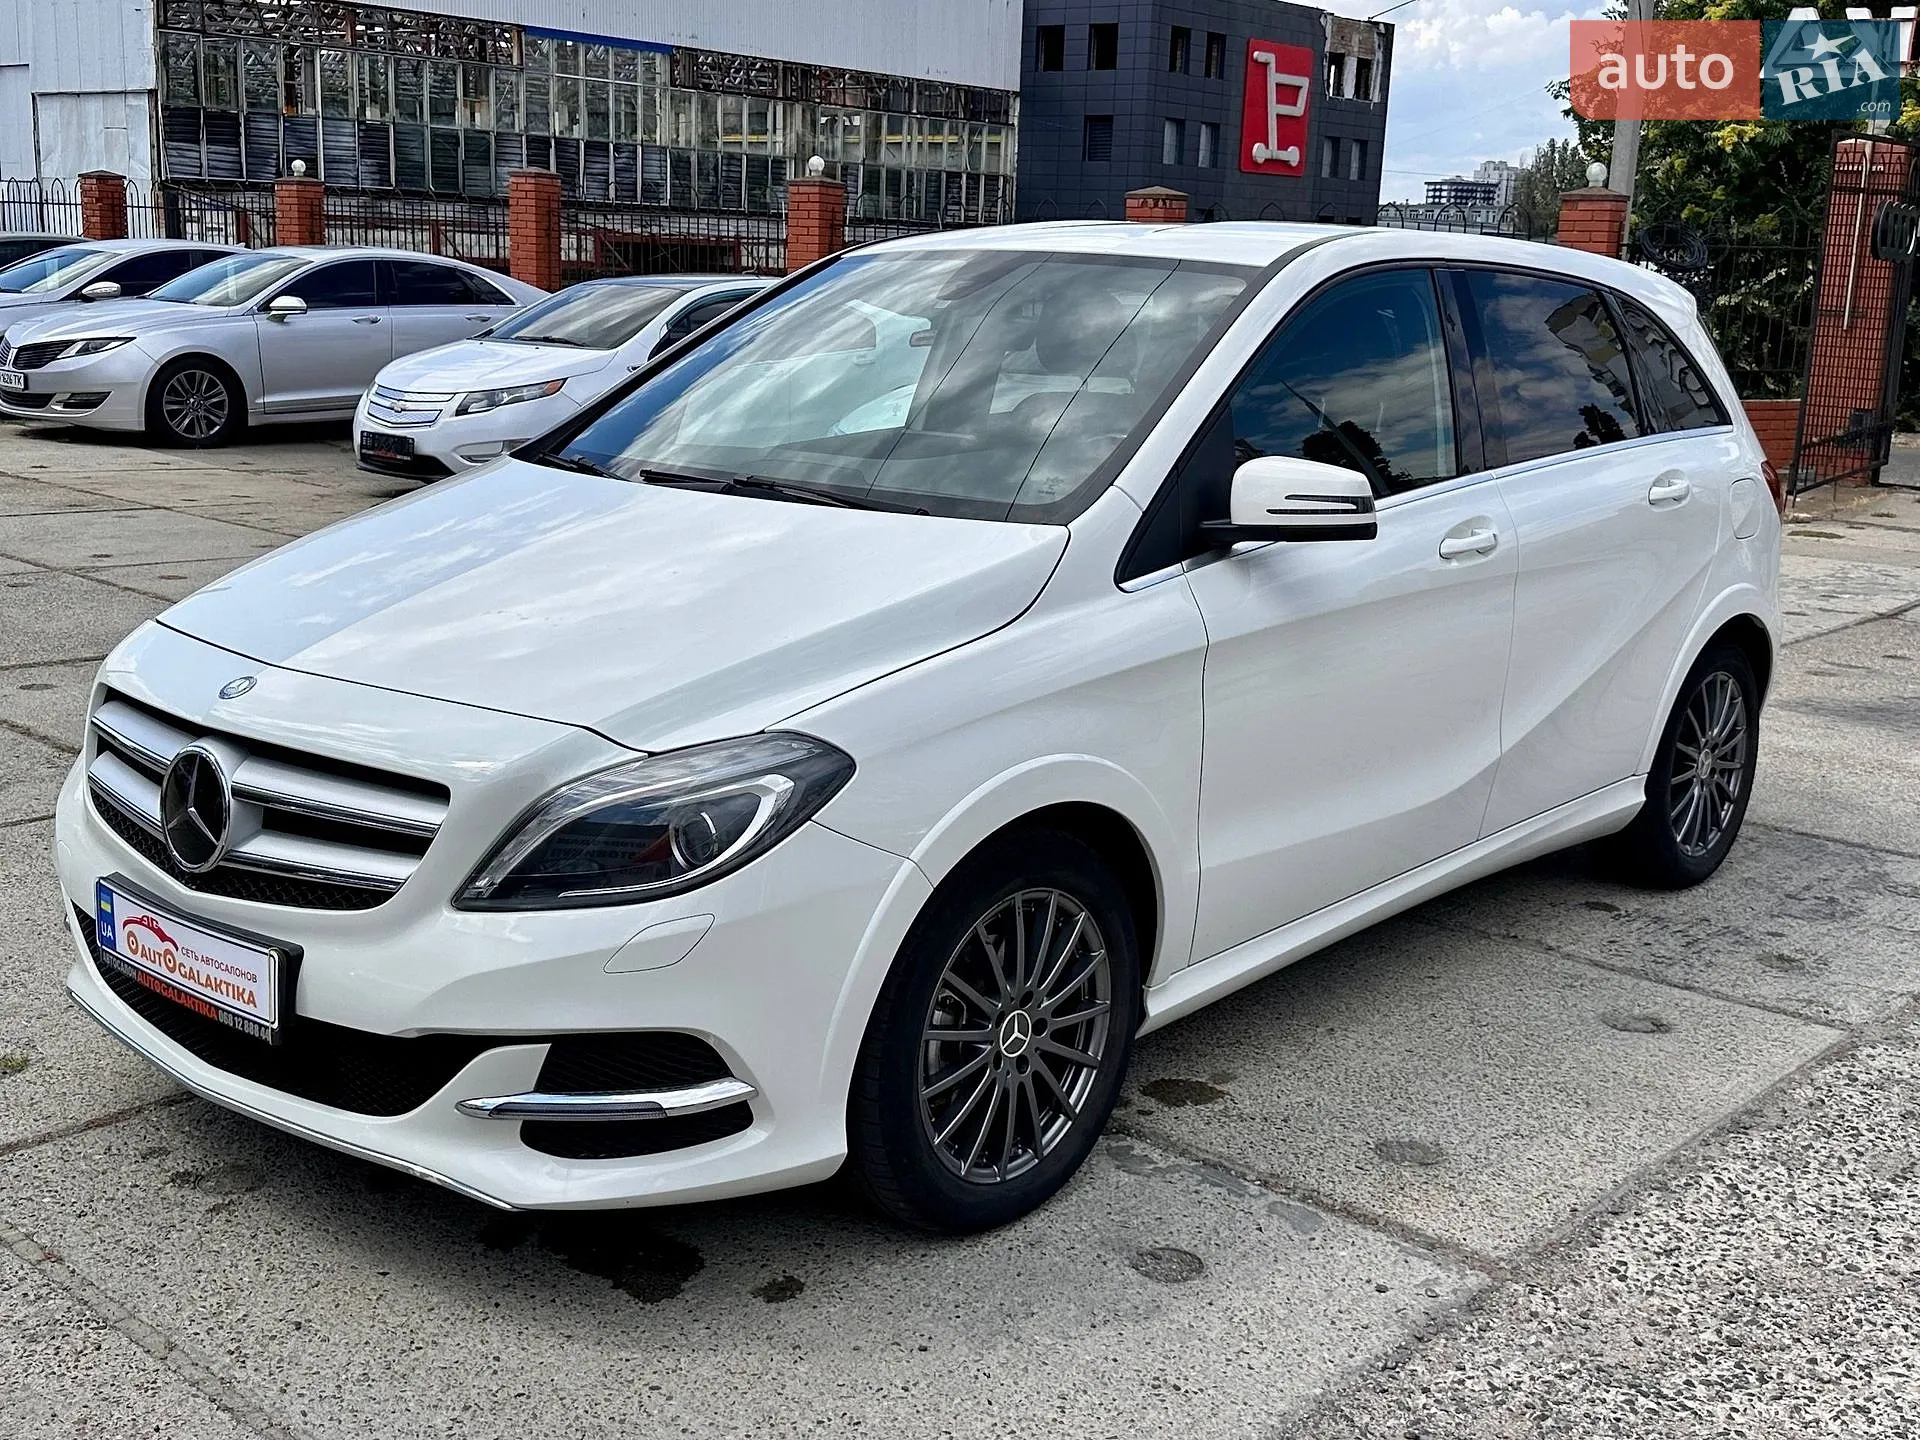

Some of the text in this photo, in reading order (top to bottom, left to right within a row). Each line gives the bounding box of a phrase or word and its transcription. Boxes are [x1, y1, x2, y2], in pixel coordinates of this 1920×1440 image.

[100, 920, 114, 940] UA
[181, 946, 258, 983] СЕТЬ АВТОСАЛОНОВ
[137, 970, 218, 1020] AUTOGALAKTIKA
[234, 1016, 243, 1031] 12
